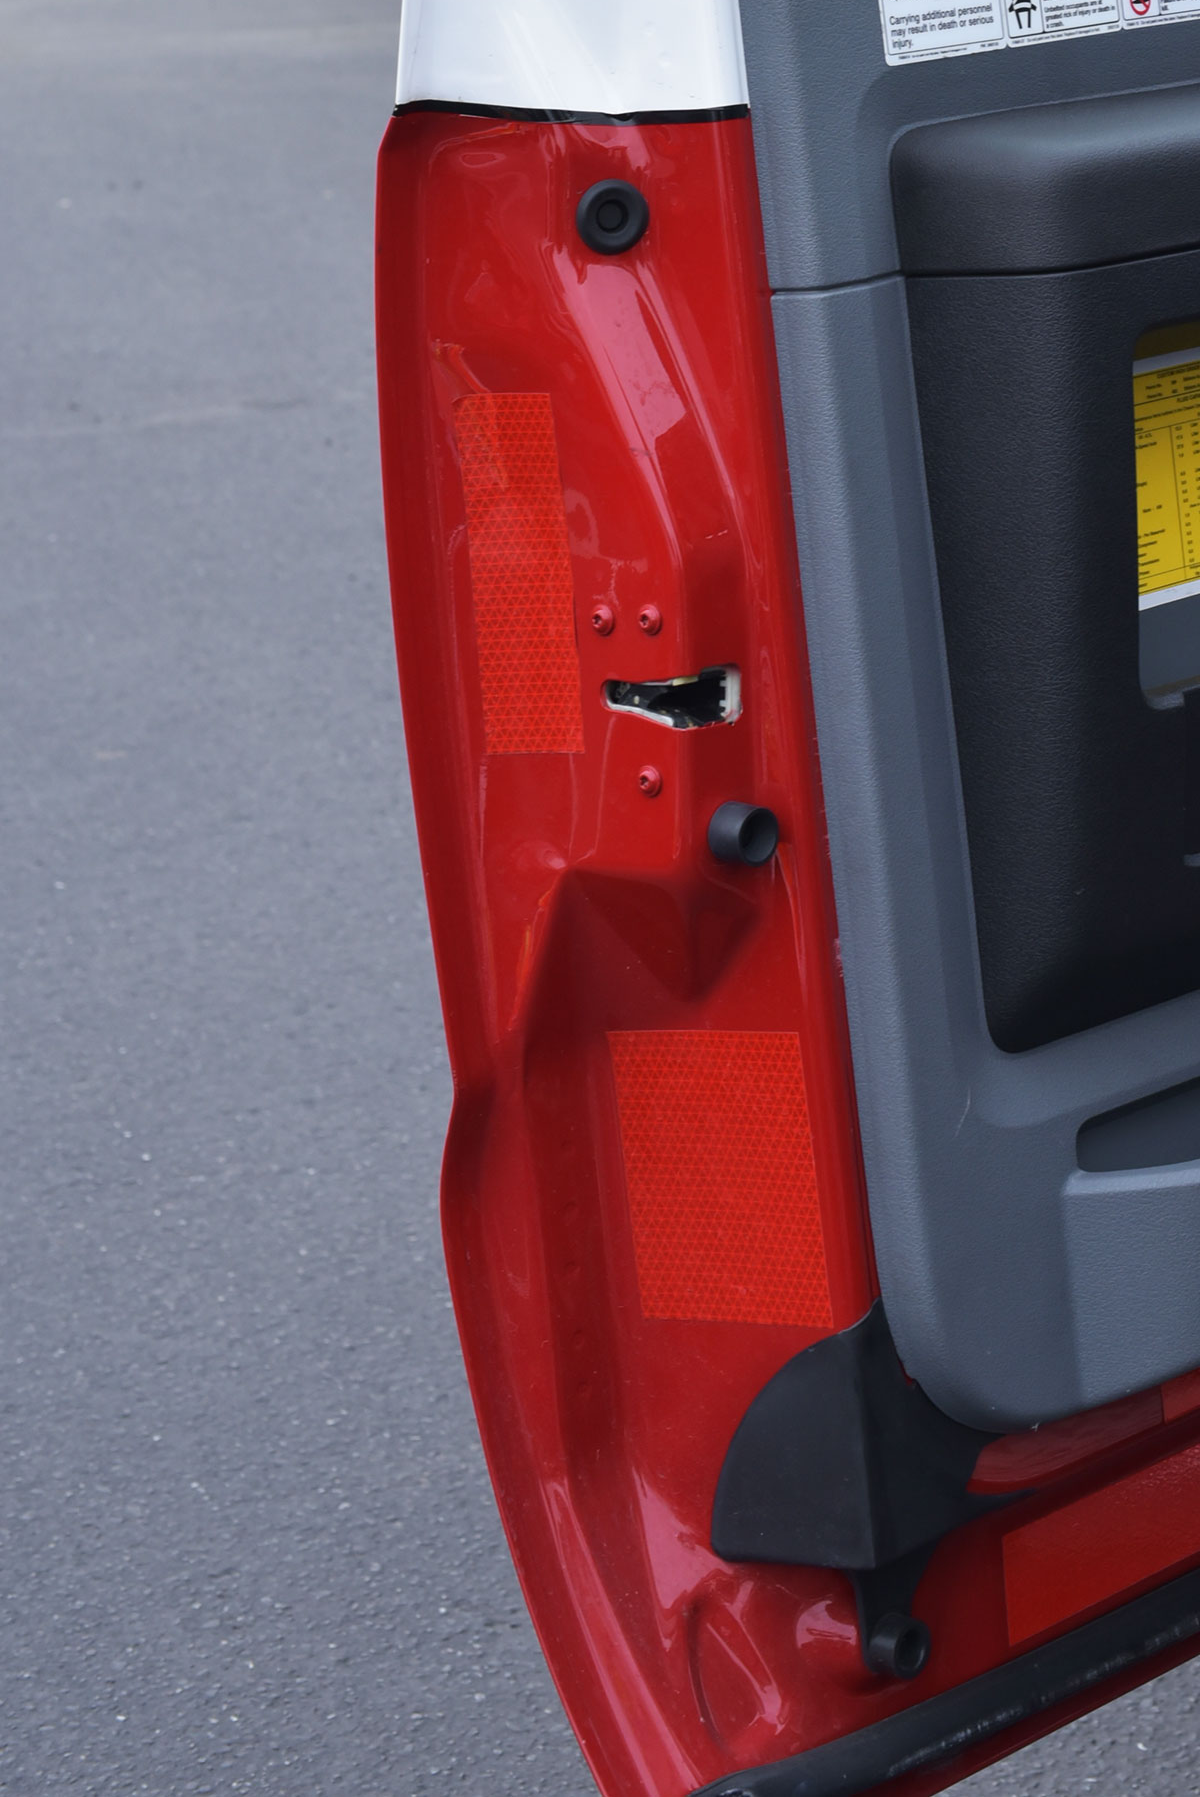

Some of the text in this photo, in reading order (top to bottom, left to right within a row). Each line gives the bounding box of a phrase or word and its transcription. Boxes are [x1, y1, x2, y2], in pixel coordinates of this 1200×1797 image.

[889, 2, 992, 25] Carrying additional personnel
[890, 15, 993, 37] may result in death or serious
[892, 38, 913, 49] injury.
